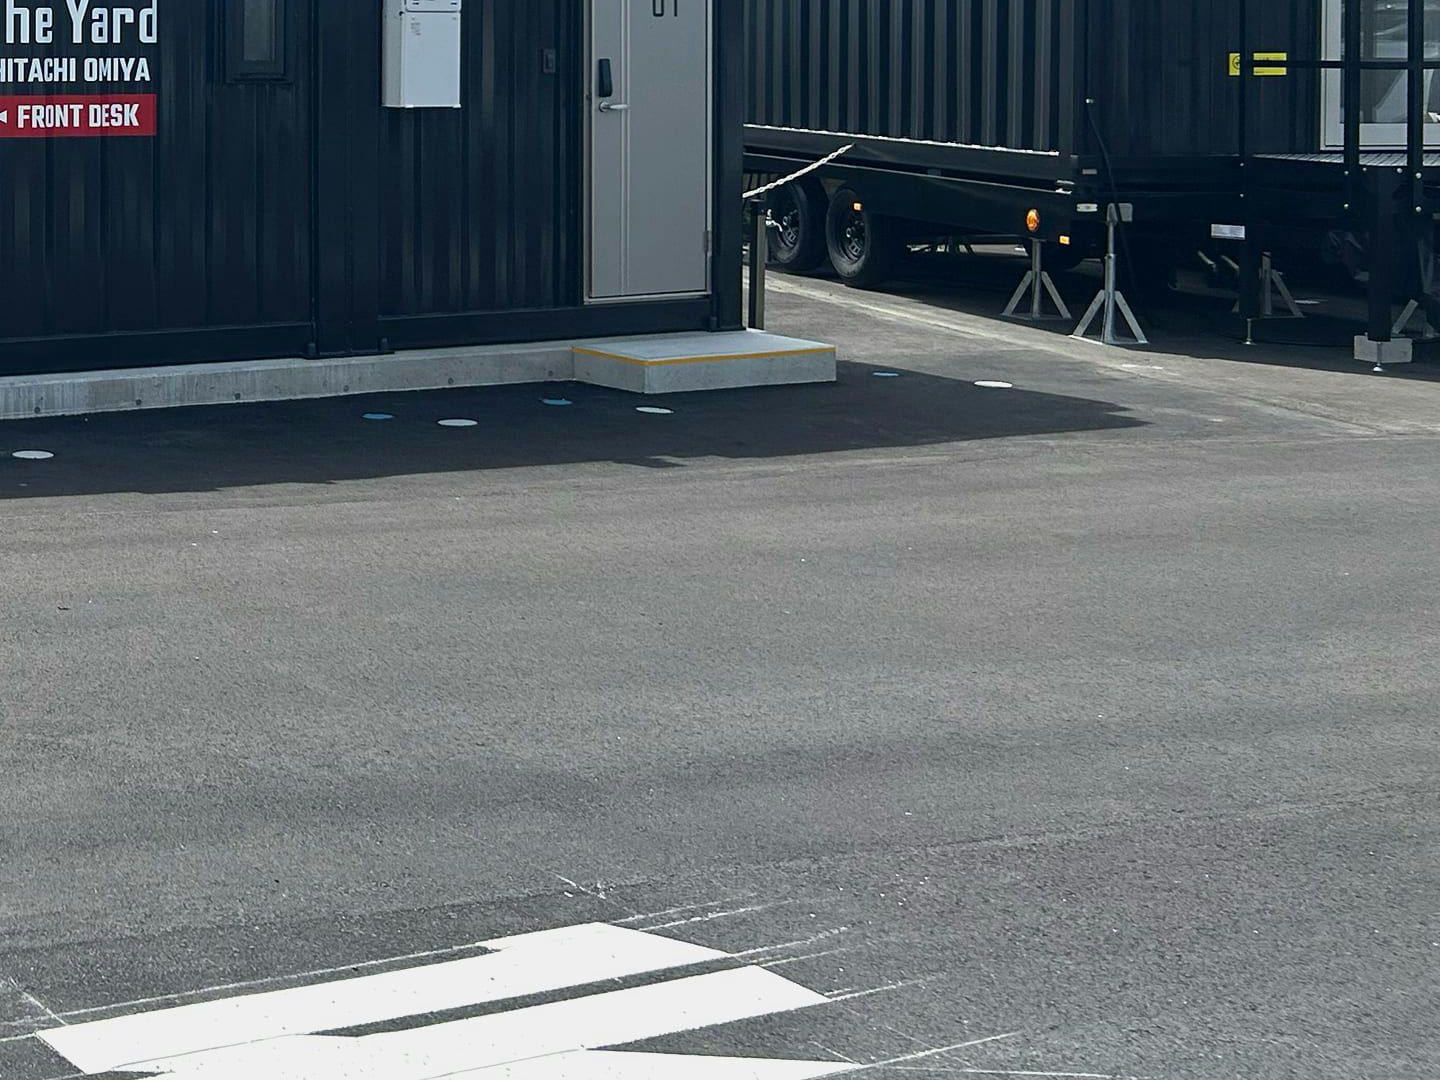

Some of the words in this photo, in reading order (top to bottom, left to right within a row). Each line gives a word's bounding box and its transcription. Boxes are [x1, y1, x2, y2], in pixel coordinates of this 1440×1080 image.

[84, 57, 151, 82] OMIYA
[17, 105, 84, 128] FRONT
[89, 103, 140, 127] DESK
